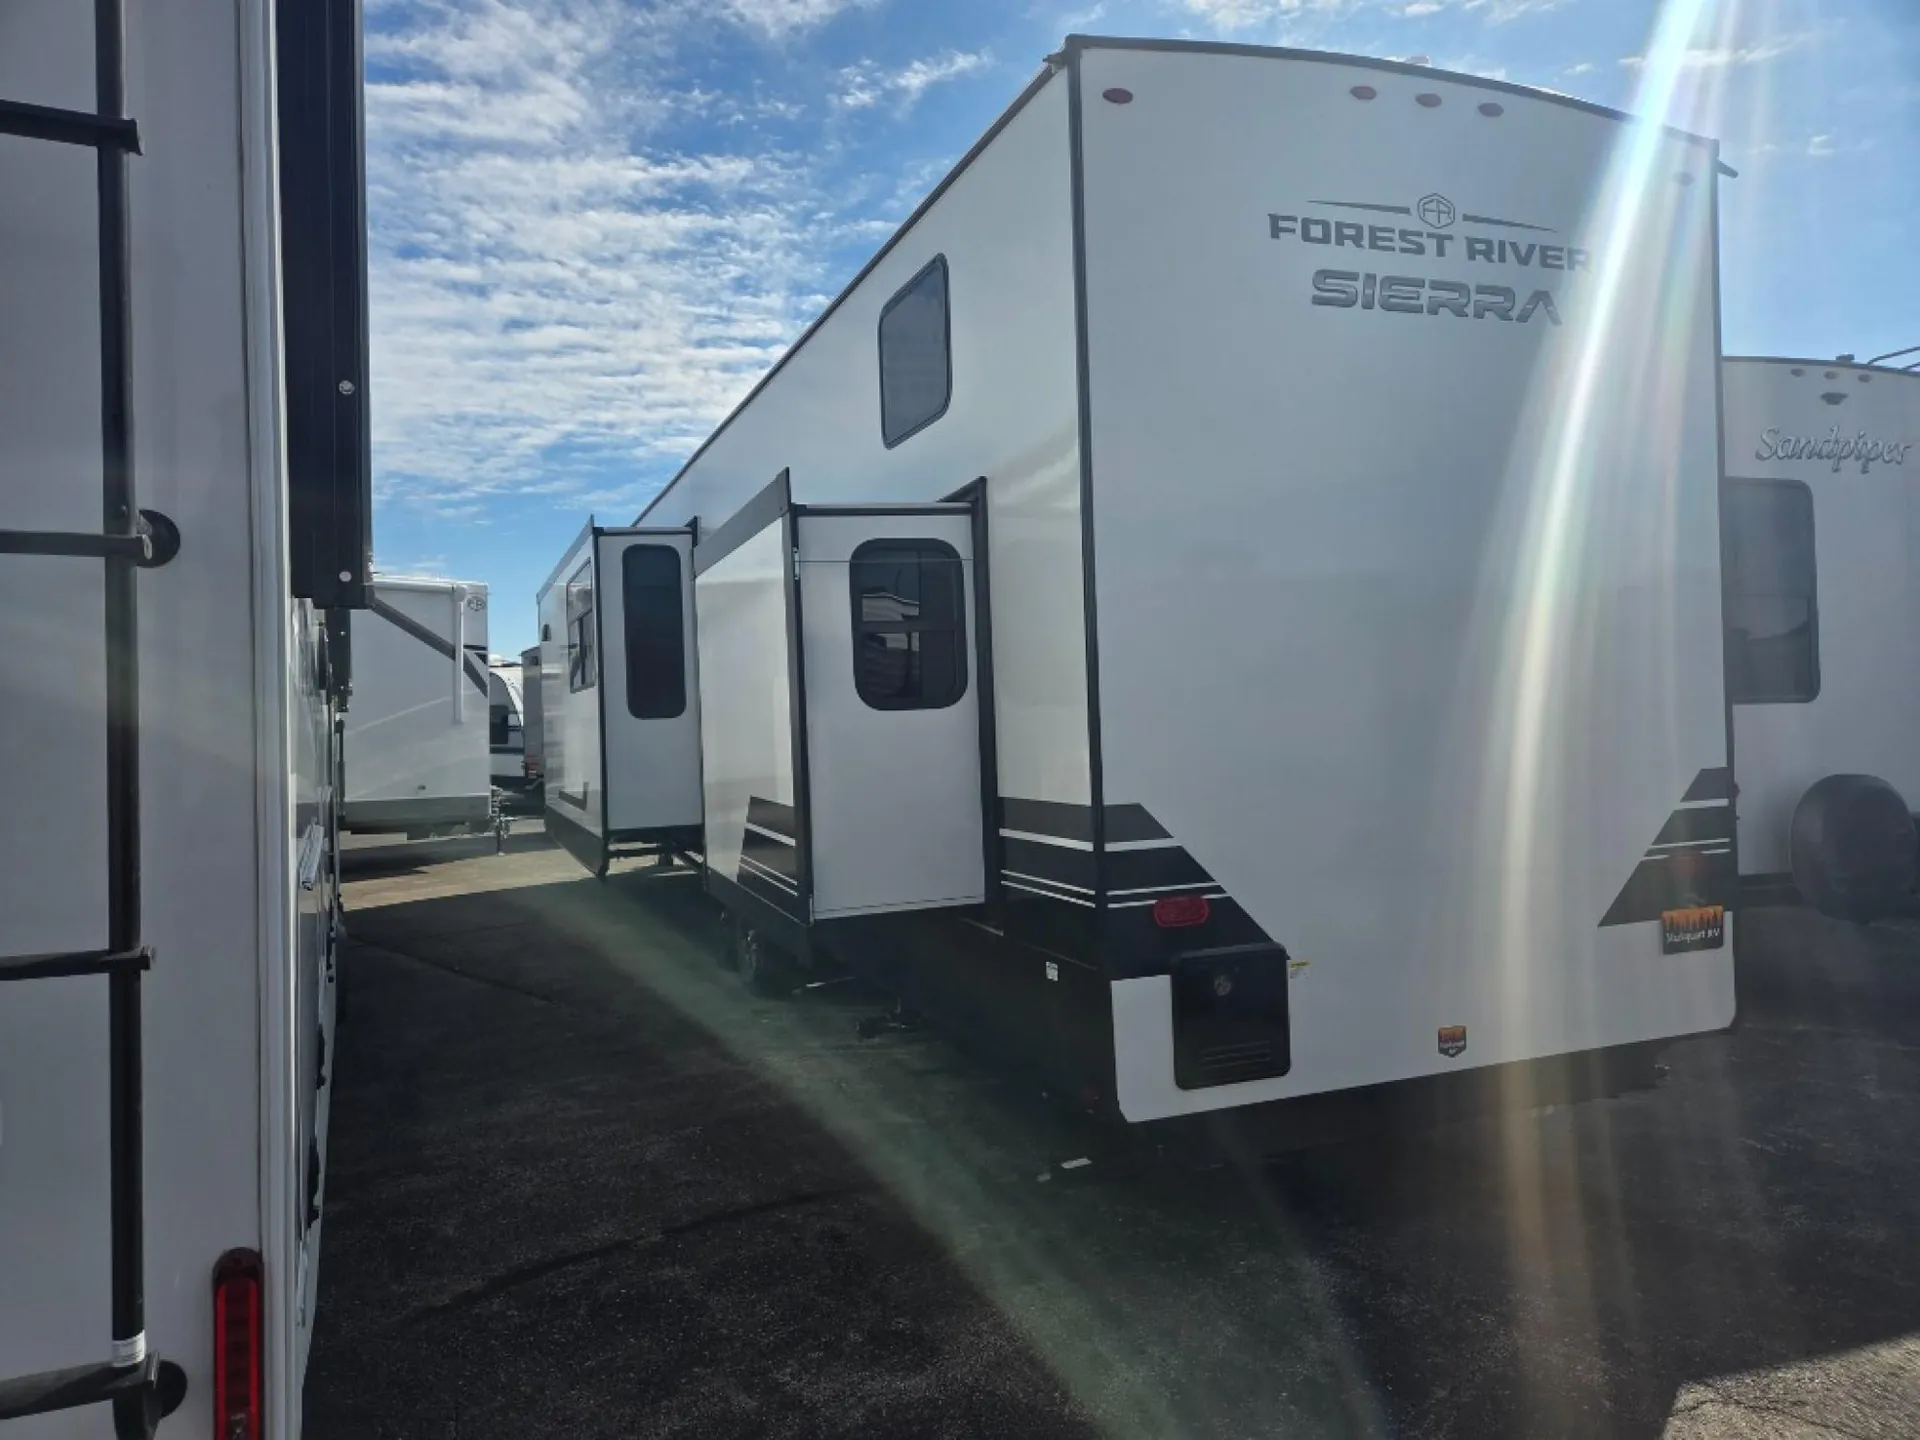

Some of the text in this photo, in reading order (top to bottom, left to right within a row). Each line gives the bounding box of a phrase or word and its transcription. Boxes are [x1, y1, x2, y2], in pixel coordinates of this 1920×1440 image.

[1267, 213, 1593, 273] FOREST RIVER
[1311, 268, 1563, 326] SIERRA
[1754, 424, 1912, 475] Sandpiper
